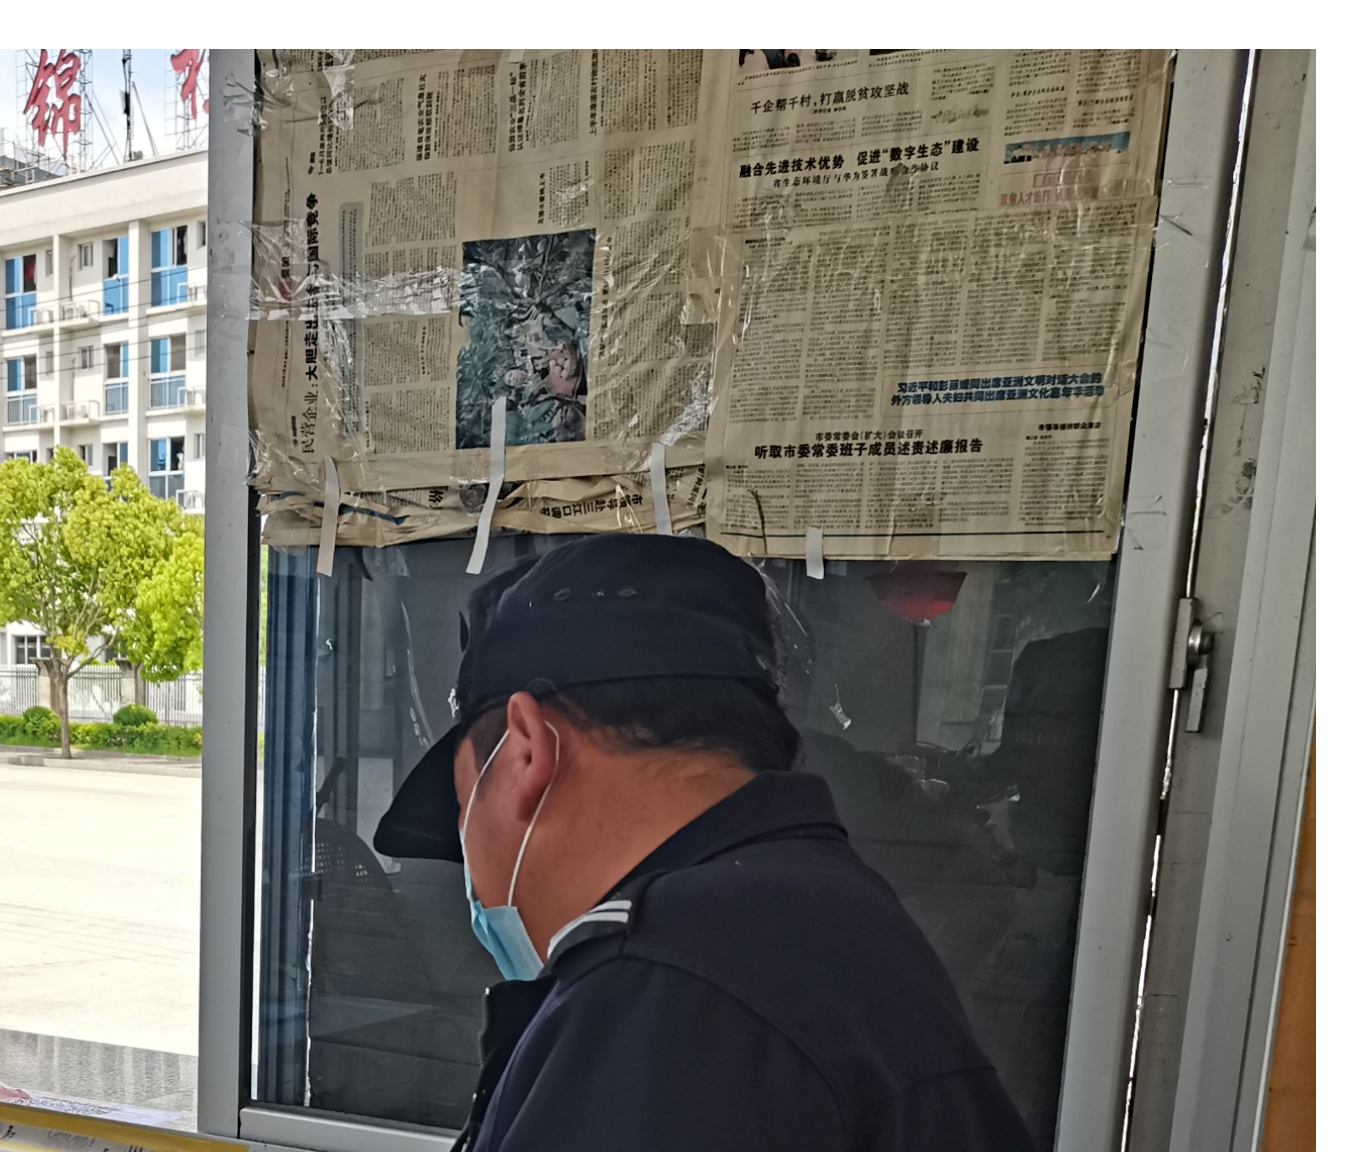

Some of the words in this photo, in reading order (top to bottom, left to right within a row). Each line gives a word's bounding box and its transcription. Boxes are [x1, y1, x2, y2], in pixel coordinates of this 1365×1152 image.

[739, 154, 845, 179] 融合先进技术优势
[753, 439, 984, 461] 听取市委常委班子成员述责述廉报告
